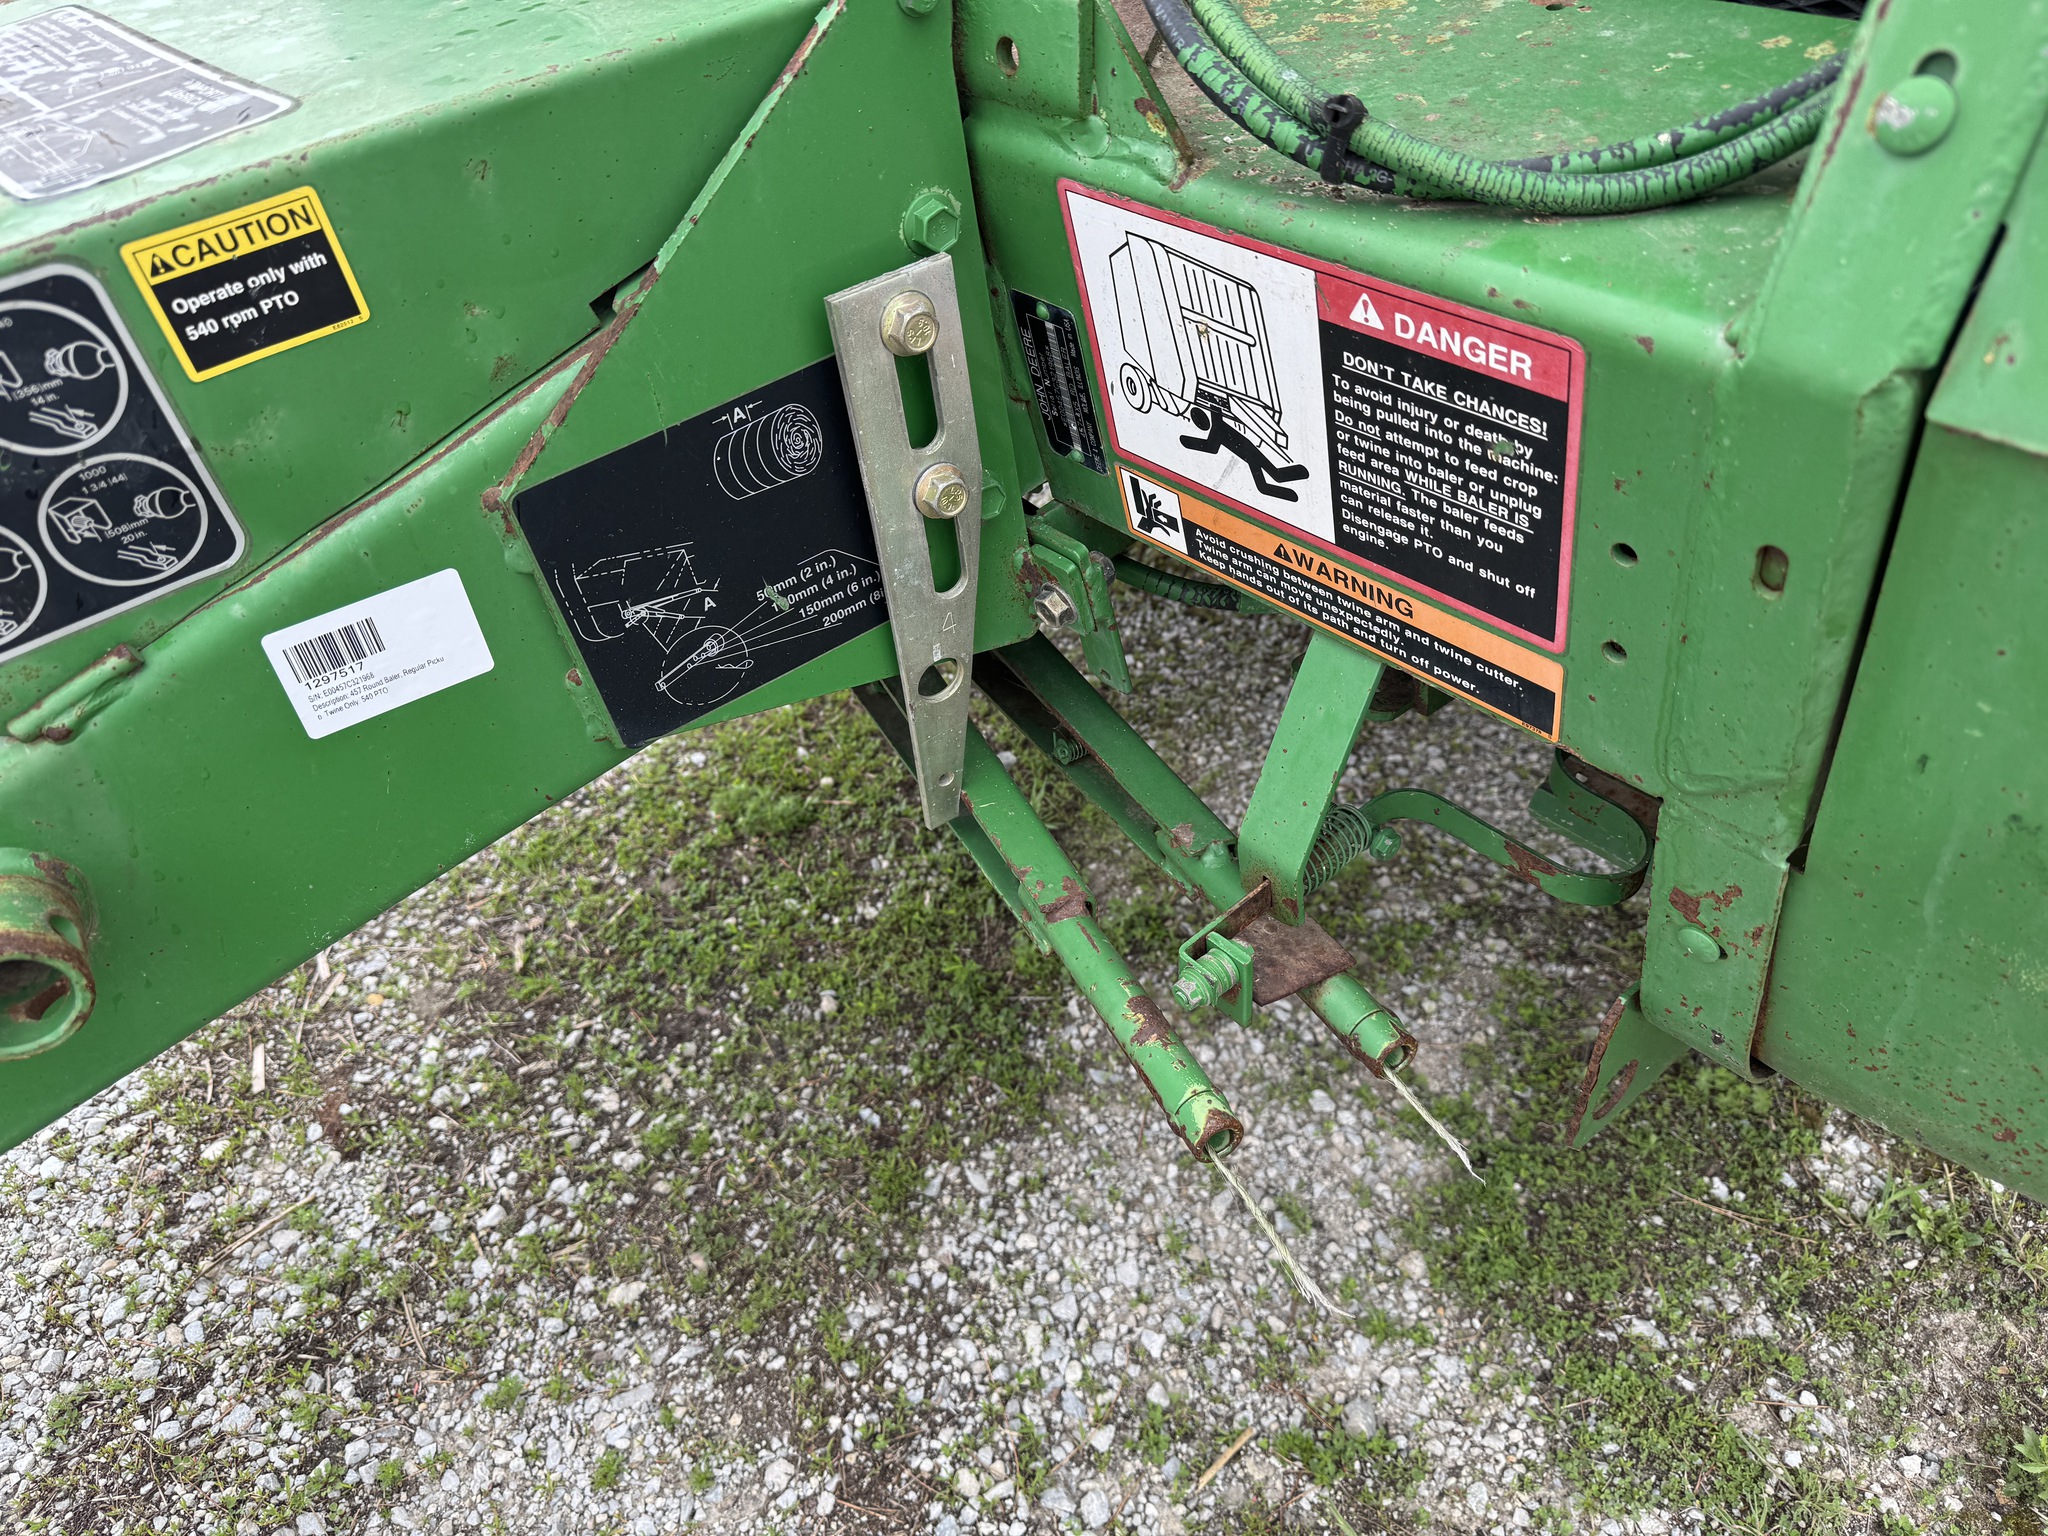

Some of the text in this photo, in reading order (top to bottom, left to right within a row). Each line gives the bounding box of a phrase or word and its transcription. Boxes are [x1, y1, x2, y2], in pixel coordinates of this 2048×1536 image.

[172, 205, 313, 266] CAUTION
[171, 252, 328, 315] Operate only with
[185, 290, 300, 341] 540 rpm PTO
[1063, 318, 1072, 331] USA
[1061, 346, 1073, 380] BALER
[1070, 343, 1078, 358] Made
[1394, 312, 1533, 380] DANGER
[1020, 327, 1051, 420] JOHN DEERE
[1039, 352, 1060, 417] Serial Number
[1073, 365, 1085, 392] ILLINOIS
[1342, 351, 1548, 436] DON’T TAKE CHANCES!
[31, 392, 60, 406] 14 in.
[732, 407, 747, 424] A
[1332, 373, 1533, 460] To avoid injury or death by
[1086, 421, 1097, 447] COMPANY
[1333, 391, 1559, 485] being pulled into the machine:
[1334, 409, 1538, 498] Do not attempt to feed crop
[79, 465, 107, 481] 1000
[1095, 452, 1104, 472] DEERE
[1336, 429, 1542, 520] or twine into baler or unplug
[1337, 443, 1530, 528] feed area WHILE BALER IS
[82, 487, 89, 495] 1
[1338, 460, 1525, 544] RUNNING. The baler feeds
[121, 531, 147, 544] 20 in.
[1339, 479, 1503, 554] material faster than you
[1340, 494, 1434, 539] can release it.
[1342, 523, 1389, 551] engine.
[800, 569, 813, 582] (2
[815, 555, 837, 573] in.)
[1341, 508, 1536, 599] Disengage PTO and shut off
[703, 597, 717, 611] A
[771, 563, 857, 613] 10mm (4 in.)
[798, 570, 881, 618] 150mm (6 in.)
[1197, 538, 1405, 646] Twine arm can move unexpectedly.
[1292, 548, 1414, 620] WARNING
[822, 599, 867, 627] 200mm
[1195, 529, 1524, 691] Avoid crushing between twine arm and twine cutter.
[1199, 549, 1480, 694] Keep hands out of its path and turn off power.
[304, 661, 364, 690] 1297517
[307, 672, 375, 703] S/N: E00457C321968
[312, 693, 350, 712] Description:
[350, 687, 362, 696] 457
[362, 677, 384, 692] Round
[402, 663, 426, 677] Regular
[426, 656, 445, 667] Picku
[324, 705, 344, 717] Twine
[361, 693, 374, 703] 540
[374, 686, 389, 697] PTO
